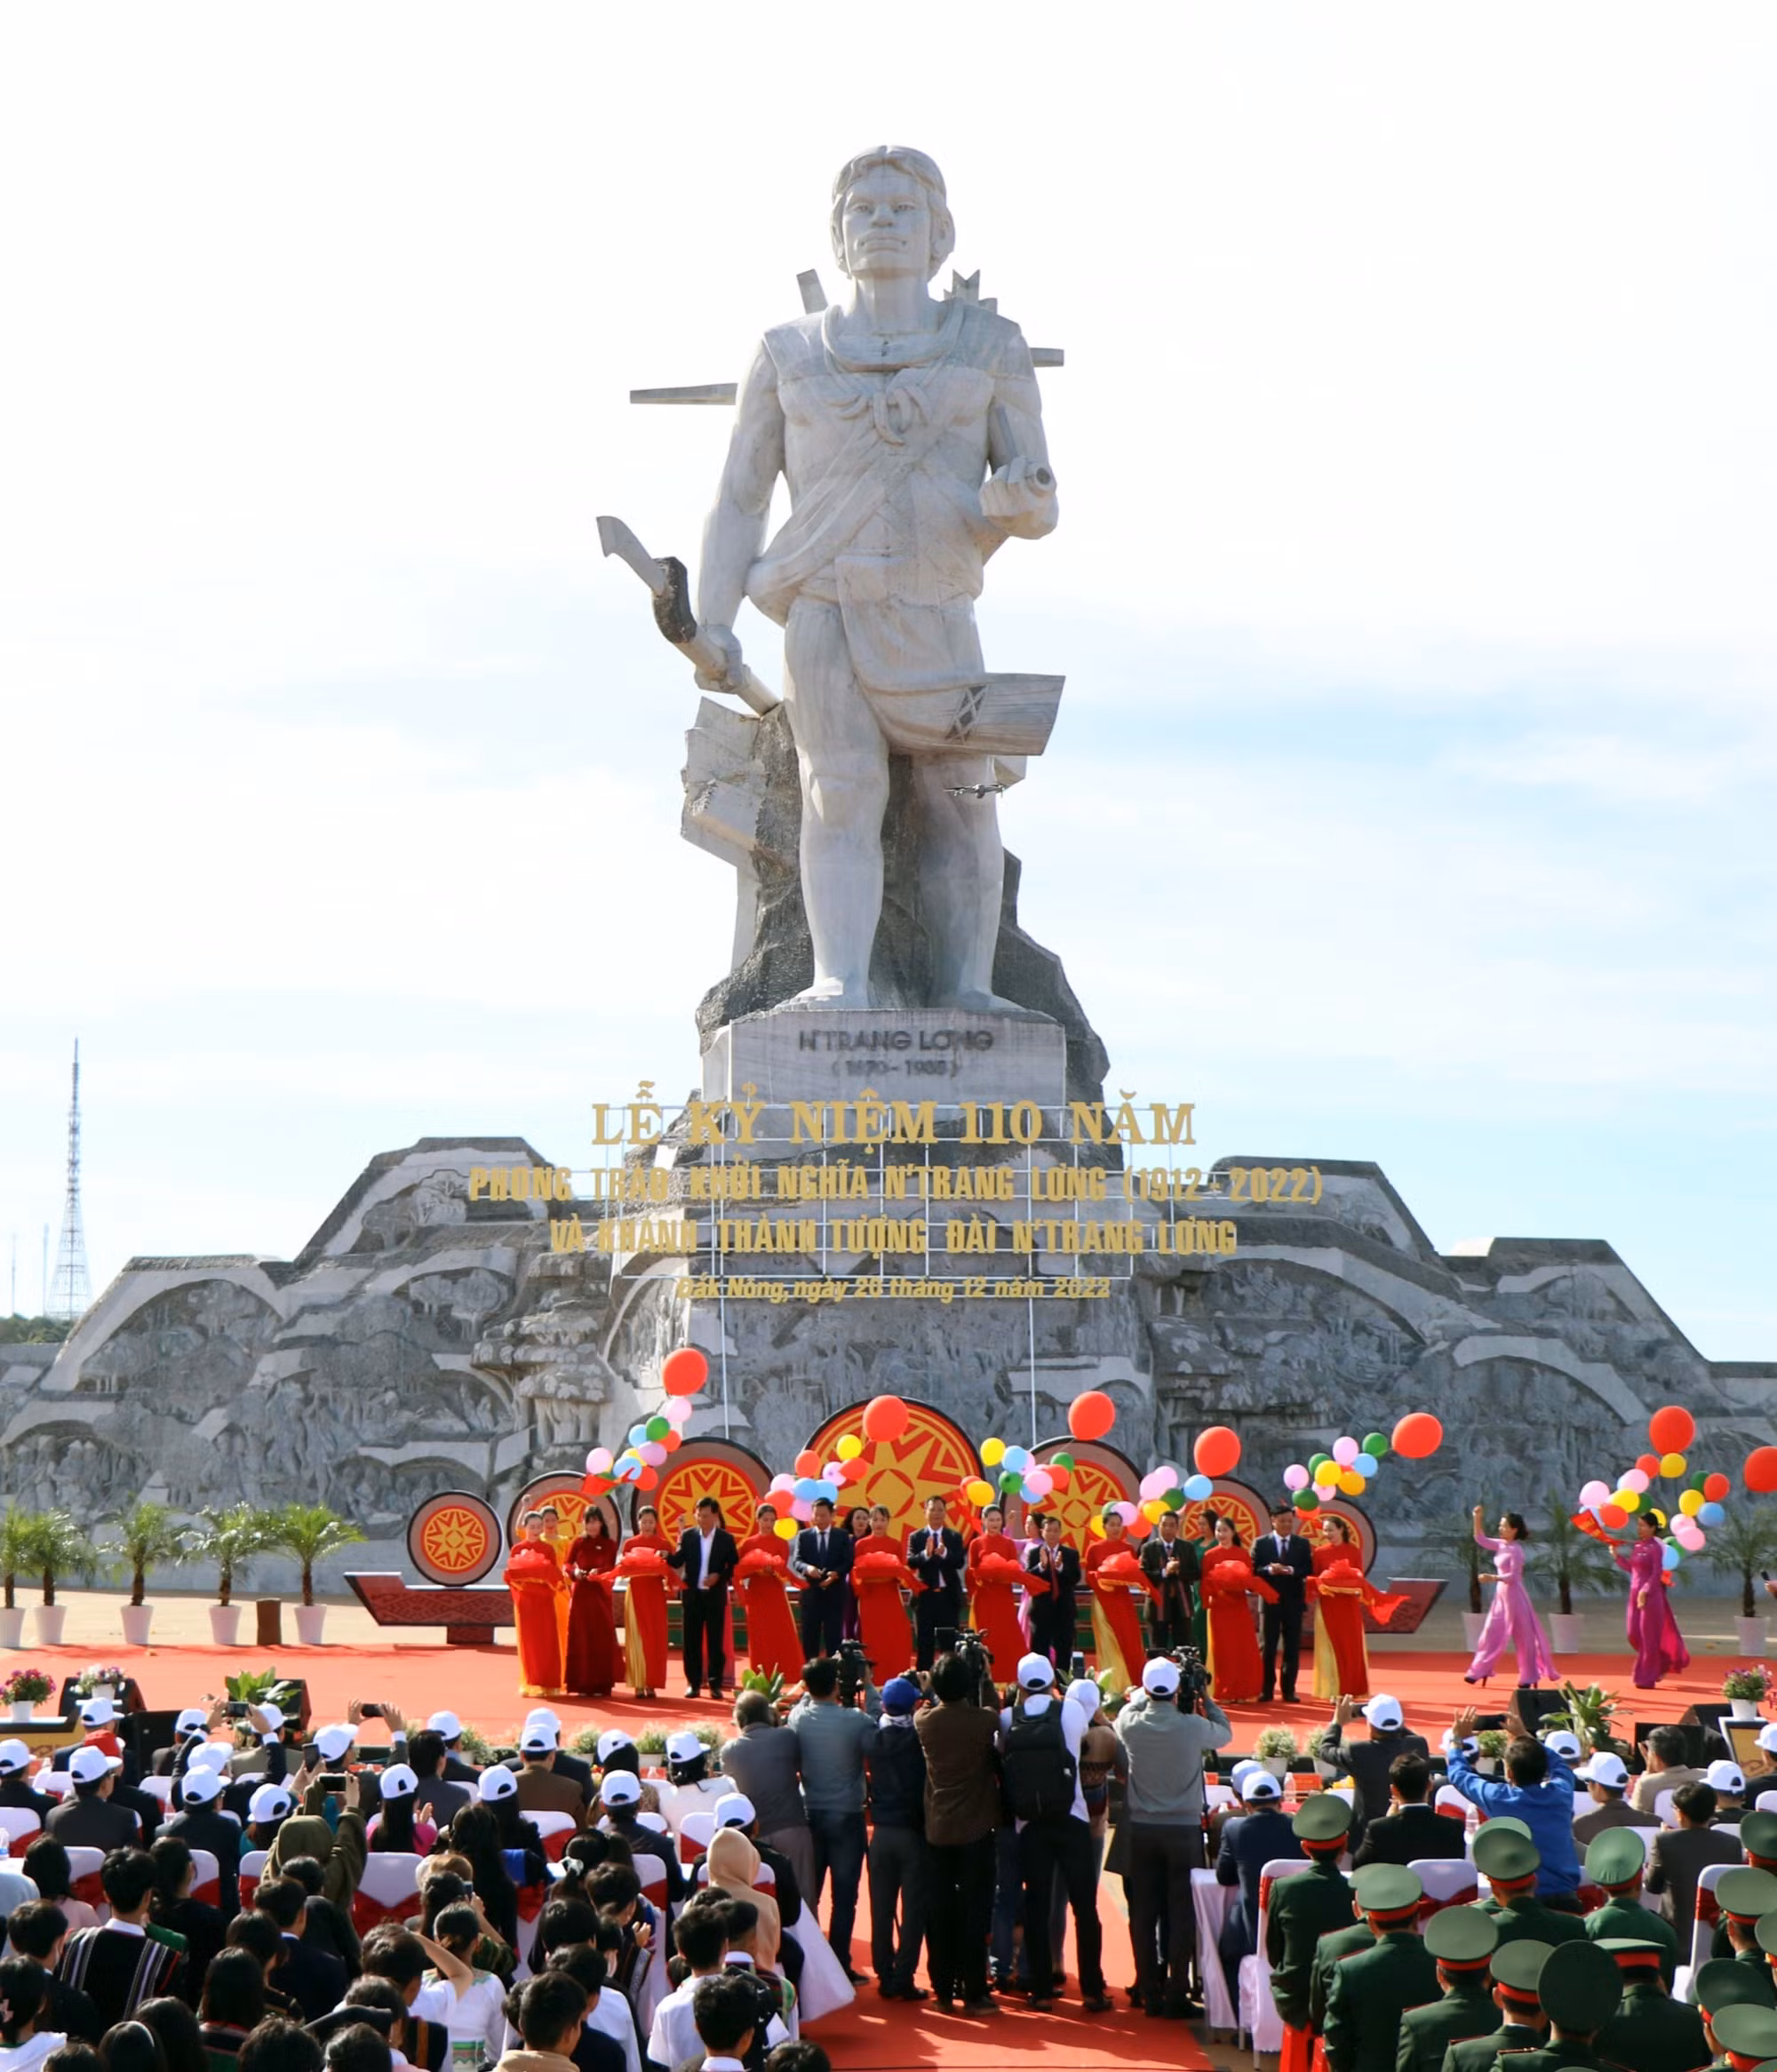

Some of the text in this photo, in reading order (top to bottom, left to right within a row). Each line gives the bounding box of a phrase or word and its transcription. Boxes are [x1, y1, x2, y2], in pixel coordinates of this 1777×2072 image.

[592, 1080, 1196, 1153] LỄ KỶ NIỆM 110 NĂM
[469, 1167, 573, 1201] PHONG
[689, 1152, 761, 1199] KHỞI
[777, 1158, 869, 1199] NGHĨA
[1032, 1162, 1107, 1201] LƠNG
[1123, 1165, 1203, 1204] (1912
[1230, 1166, 1323, 1205] 2022)
[550, 1213, 585, 1253] VÀ
[717, 1212, 817, 1253] THÀNH
[828, 1214, 926, 1259] TƯỢNG
[945, 1213, 996, 1254] ĐÀI
[1159, 1215, 1237, 1255] LƠNG
[726, 1277, 789, 1303] Nông,
[793, 1277, 849, 1303] ngày
[854, 1277, 883, 1298] 20
[889, 1276, 954, 1303] tháng
[962, 1277, 985, 1297] 12
[995, 1275, 1045, 1298] năm
[1055, 1277, 1110, 1298] 2022
